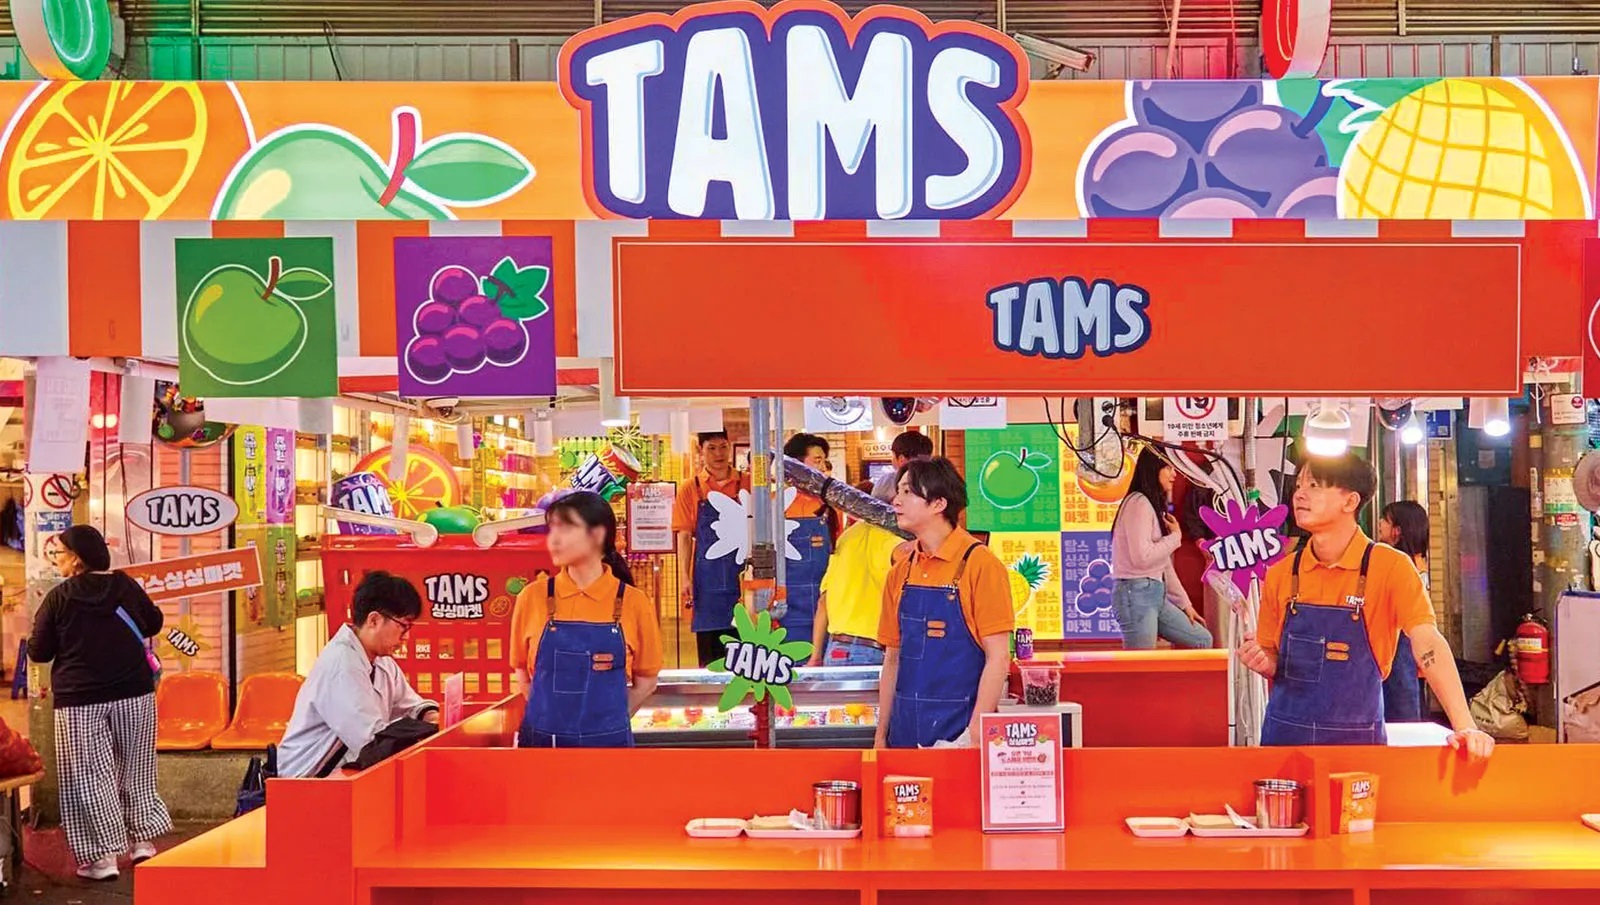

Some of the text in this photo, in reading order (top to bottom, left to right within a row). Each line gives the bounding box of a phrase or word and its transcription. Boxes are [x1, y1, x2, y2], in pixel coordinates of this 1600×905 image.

[585, 25, 1003, 219] TAMS
[989, 279, 1145, 355] TAMS
[147, 494, 219, 527] TAMS
[339, 484, 394, 516] TAM
[1064, 539, 1089, 553] 탐스
[1208, 528, 1281, 570] TAMS
[424, 574, 489, 604] TAMS
[431, 603, 484, 619] 싱싱마켓
[1066, 620, 1092, 633] 마켓
[168, 628, 200, 657] TAMS
[724, 642, 792, 684] TAMS
[1005, 723, 1037, 740] TAMS
[894, 784, 920, 798] TAMS
[1352, 780, 1370, 793] TAMS
